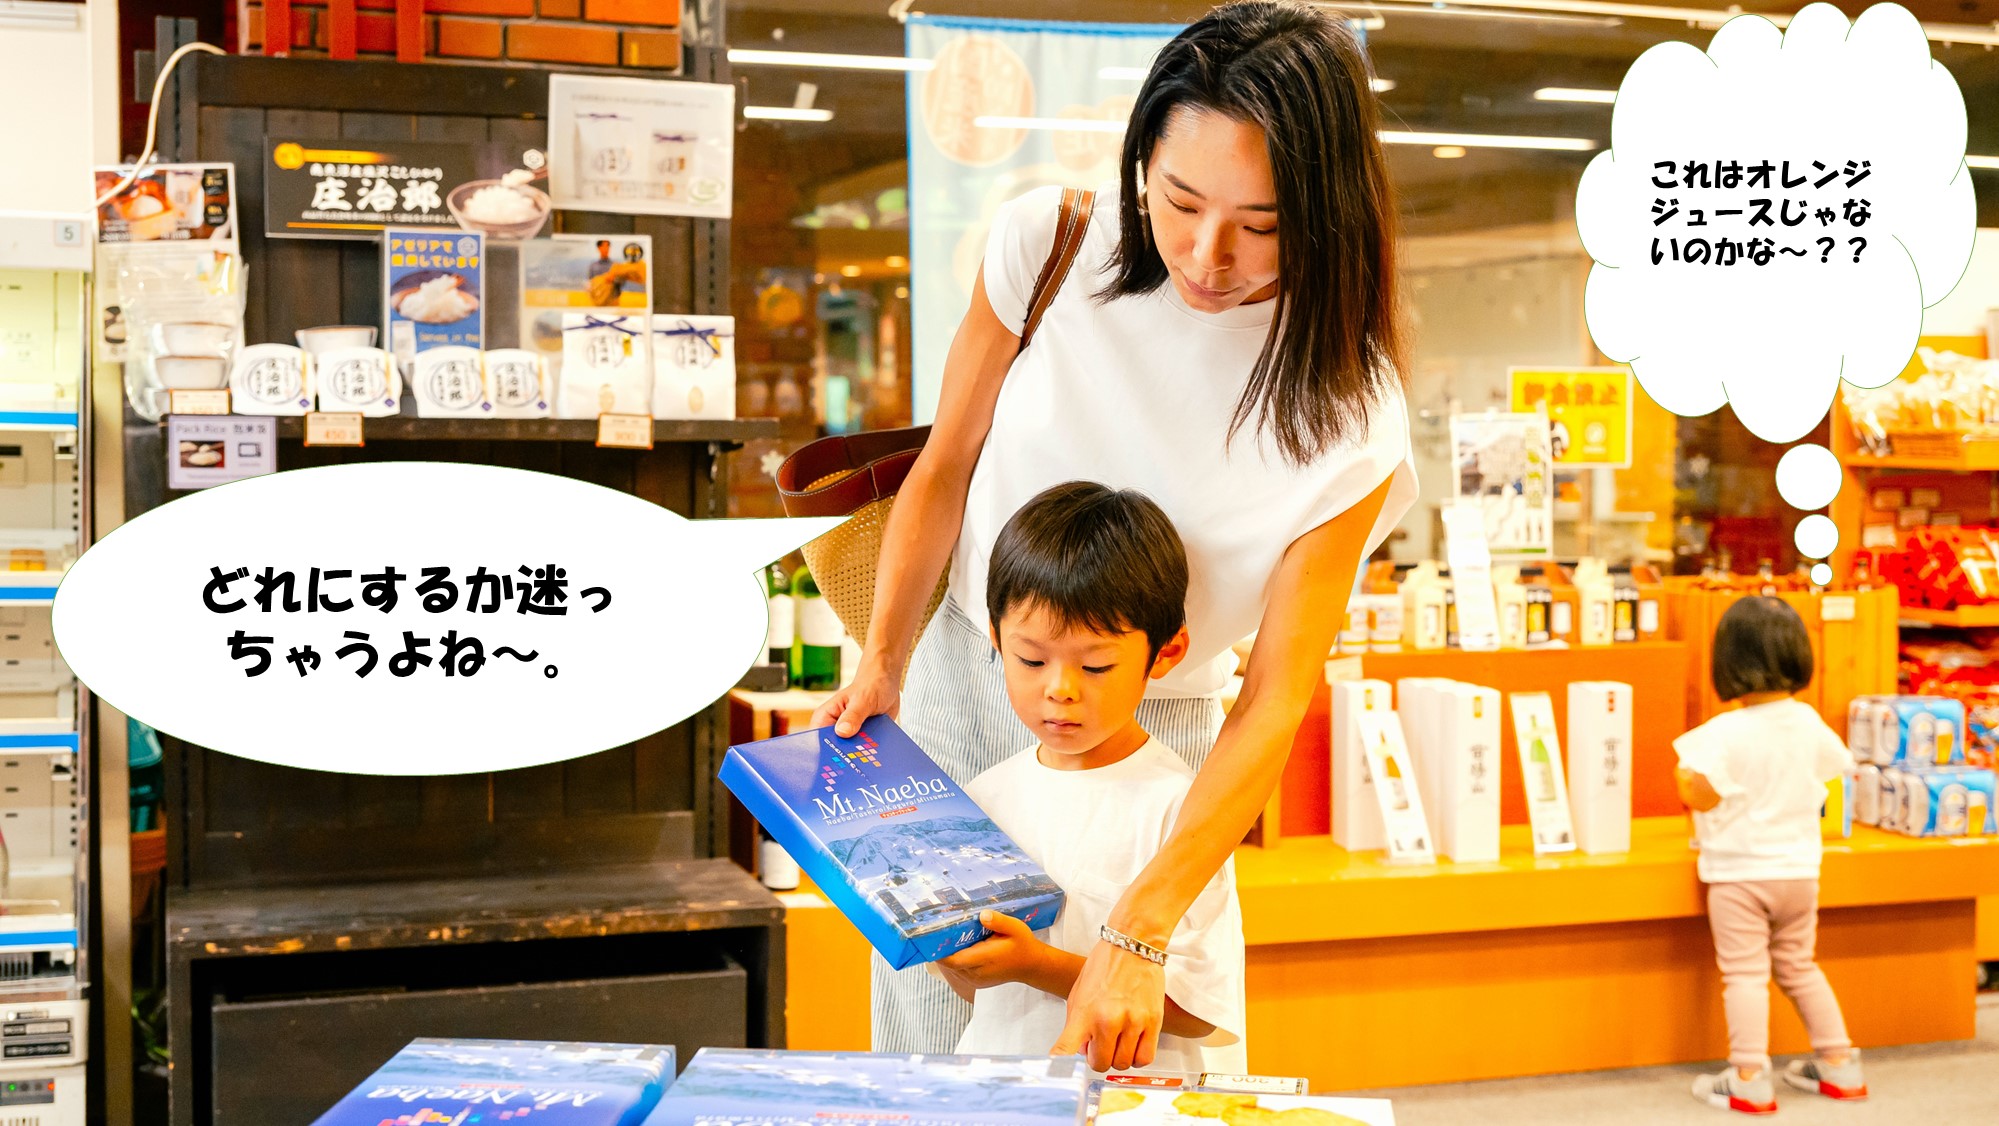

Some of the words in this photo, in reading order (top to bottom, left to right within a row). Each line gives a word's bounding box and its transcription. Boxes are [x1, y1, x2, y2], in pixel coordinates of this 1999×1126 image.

[311, 177, 442, 214] 庄治郎
[64, 226, 75, 241] 5
